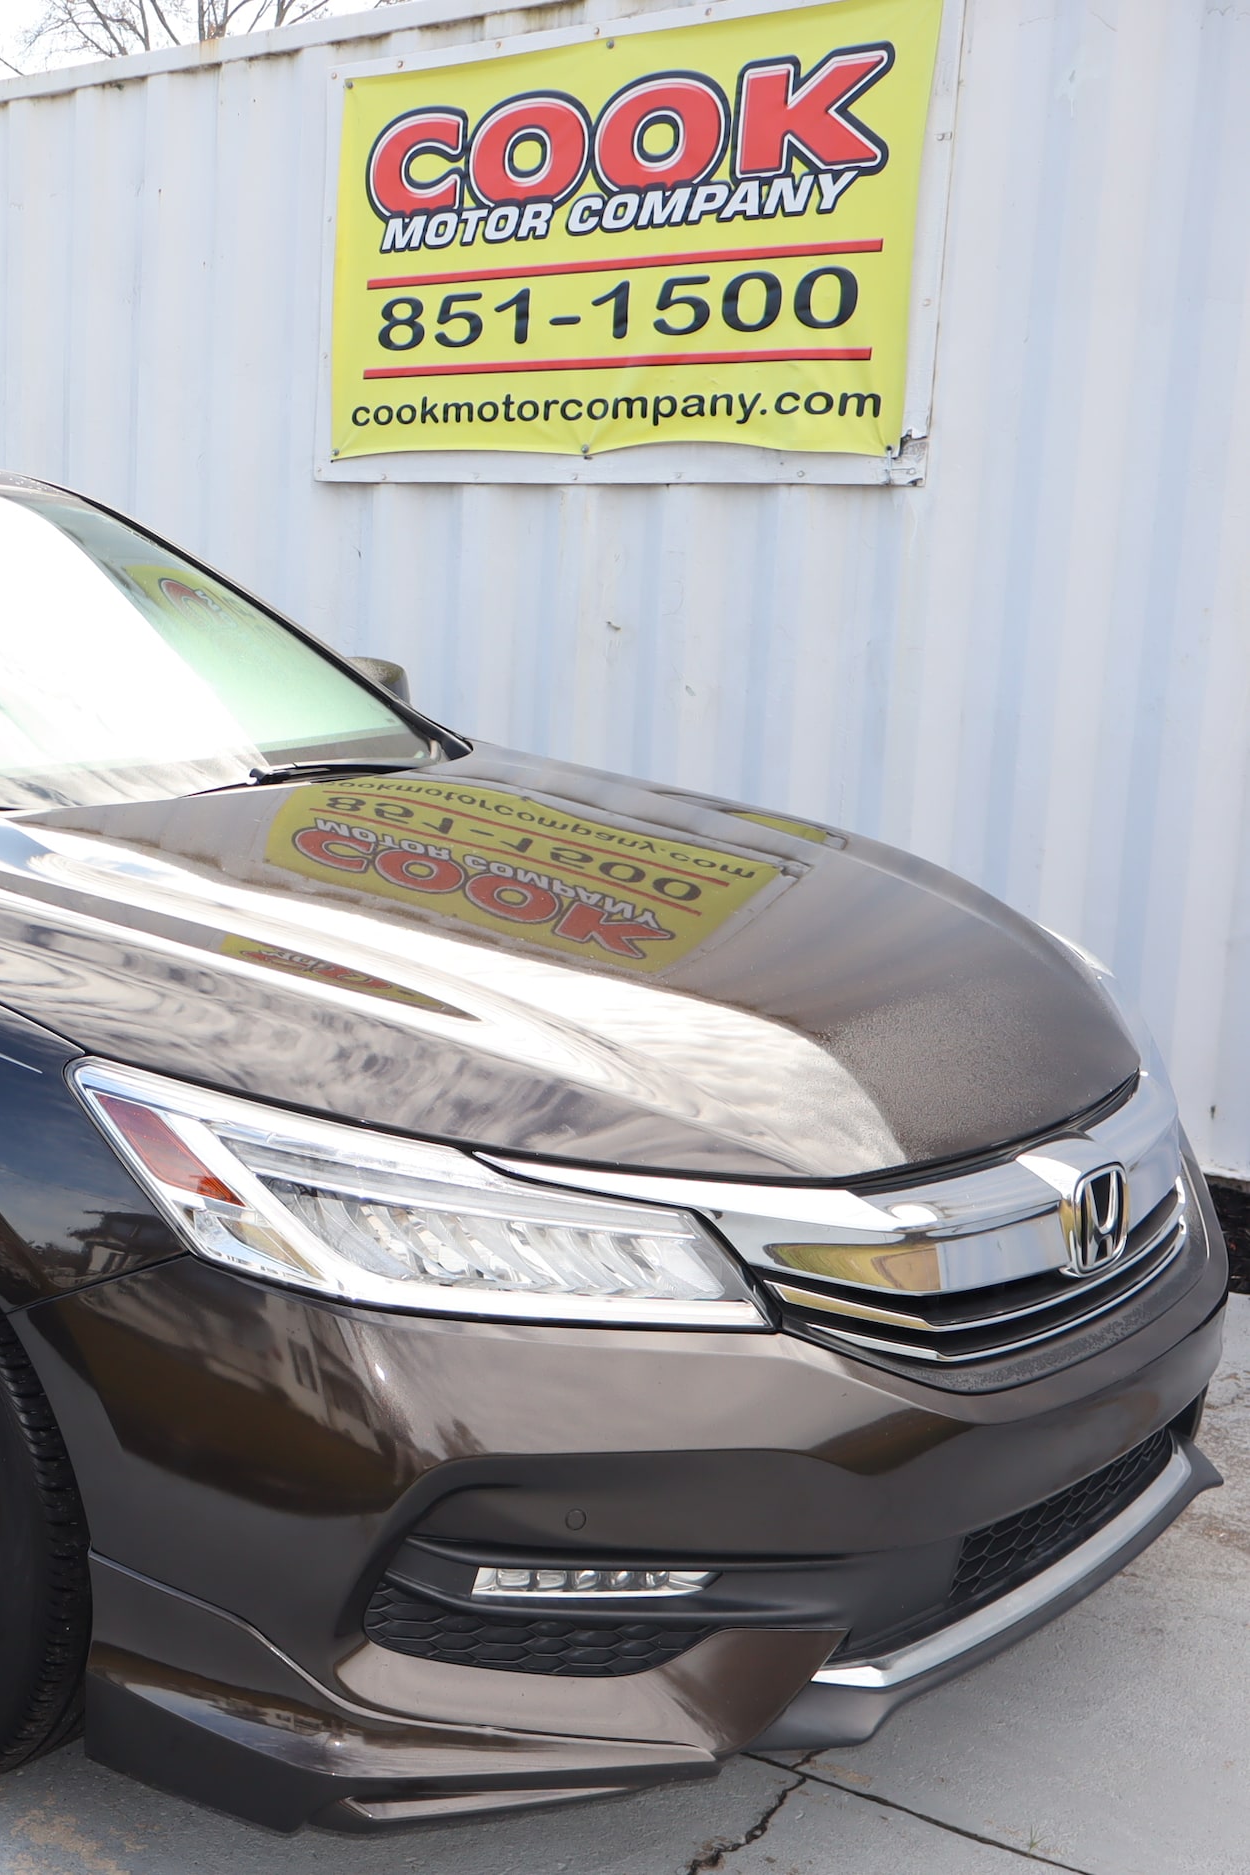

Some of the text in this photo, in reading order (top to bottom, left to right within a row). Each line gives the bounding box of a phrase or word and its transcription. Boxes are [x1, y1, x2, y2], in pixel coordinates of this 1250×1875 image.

[366, 41, 896, 221] COOK
[380, 168, 859, 253] MOTOR COMPANY
[377, 266, 859, 351] 851-1500
[351, 389, 882, 427] cookmotorcompany.com
